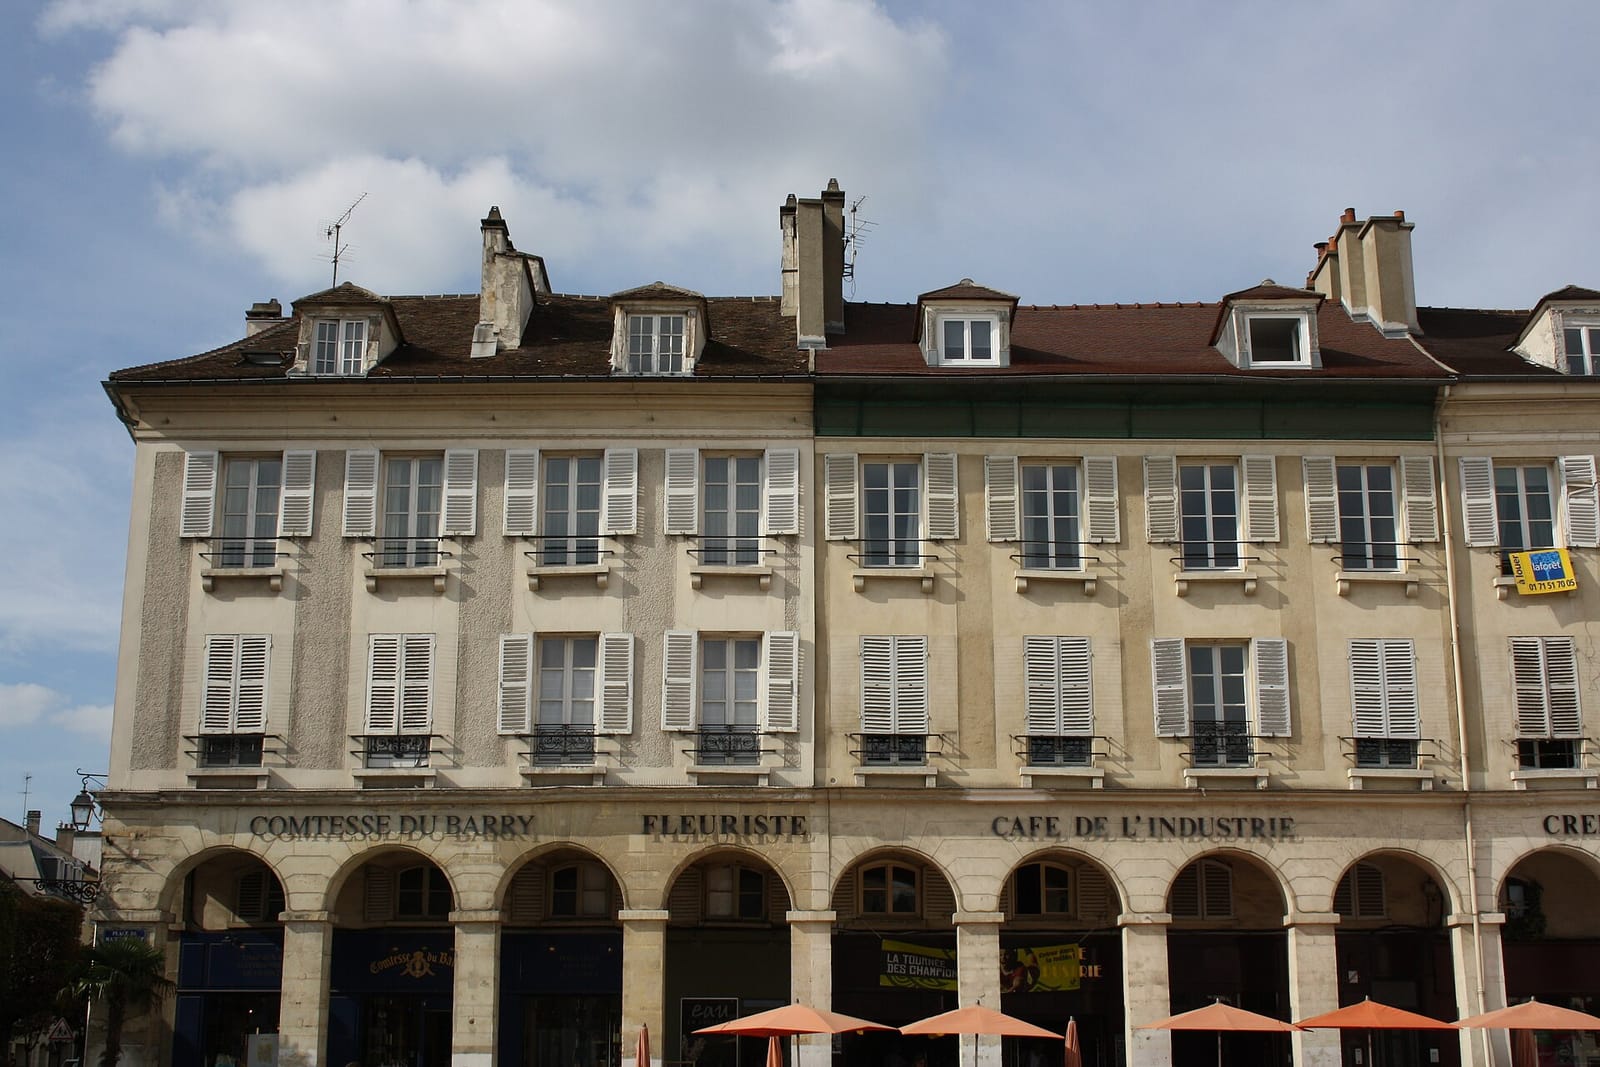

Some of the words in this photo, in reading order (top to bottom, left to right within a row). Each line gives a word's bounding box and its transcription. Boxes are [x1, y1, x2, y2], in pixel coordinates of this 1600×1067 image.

[1512, 555, 1523, 577] louer
[1532, 561, 1562, 571] laforêt
[1529, 583, 1537, 591] 01
[1547, 581, 1556, 589] 51
[1557, 580, 1566, 588] 70
[250, 815, 391, 837] COMTESSE
[400, 815, 438, 836] DU
[446, 815, 536, 836] BARRY
[642, 815, 808, 836] FLEURISTE
[992, 816, 1061, 838] CAFE
[1076, 816, 1109, 837] DE
[1122, 815, 1296, 839] L'INDUSTRIE
[1543, 814, 1600, 835] CRE
[369, 952, 410, 974] Comtesse
[887, 953, 900, 963] LA
[887, 963, 906, 974] DES
[691, 1003, 729, 1019] eau
